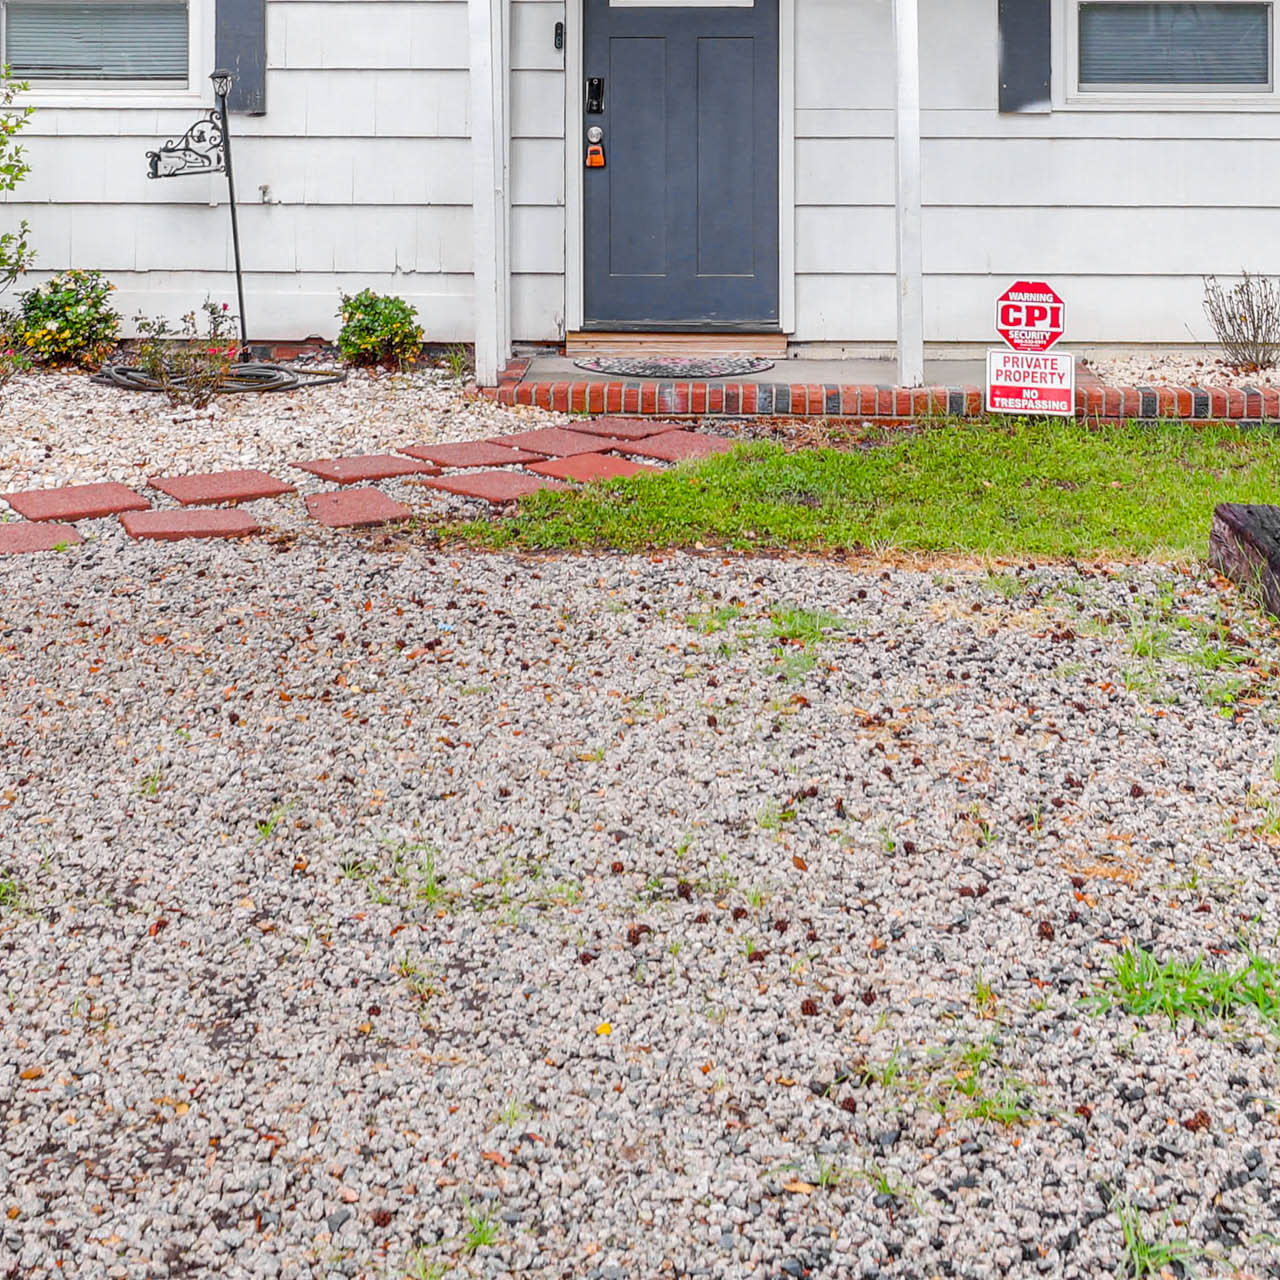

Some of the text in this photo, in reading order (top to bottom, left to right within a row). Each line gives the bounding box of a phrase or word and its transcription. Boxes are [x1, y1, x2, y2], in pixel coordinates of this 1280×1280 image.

[1009, 292, 1054, 302] WARNING
[1001, 304, 1061, 328] CPI
[1009, 330, 1050, 340] SECURITY
[1003, 356, 1058, 370] PRIVATE
[996, 369, 1065, 384] PROPERTY
[1022, 389, 1039, 399] NO
[994, 398, 1068, 411] TRESPASSING
